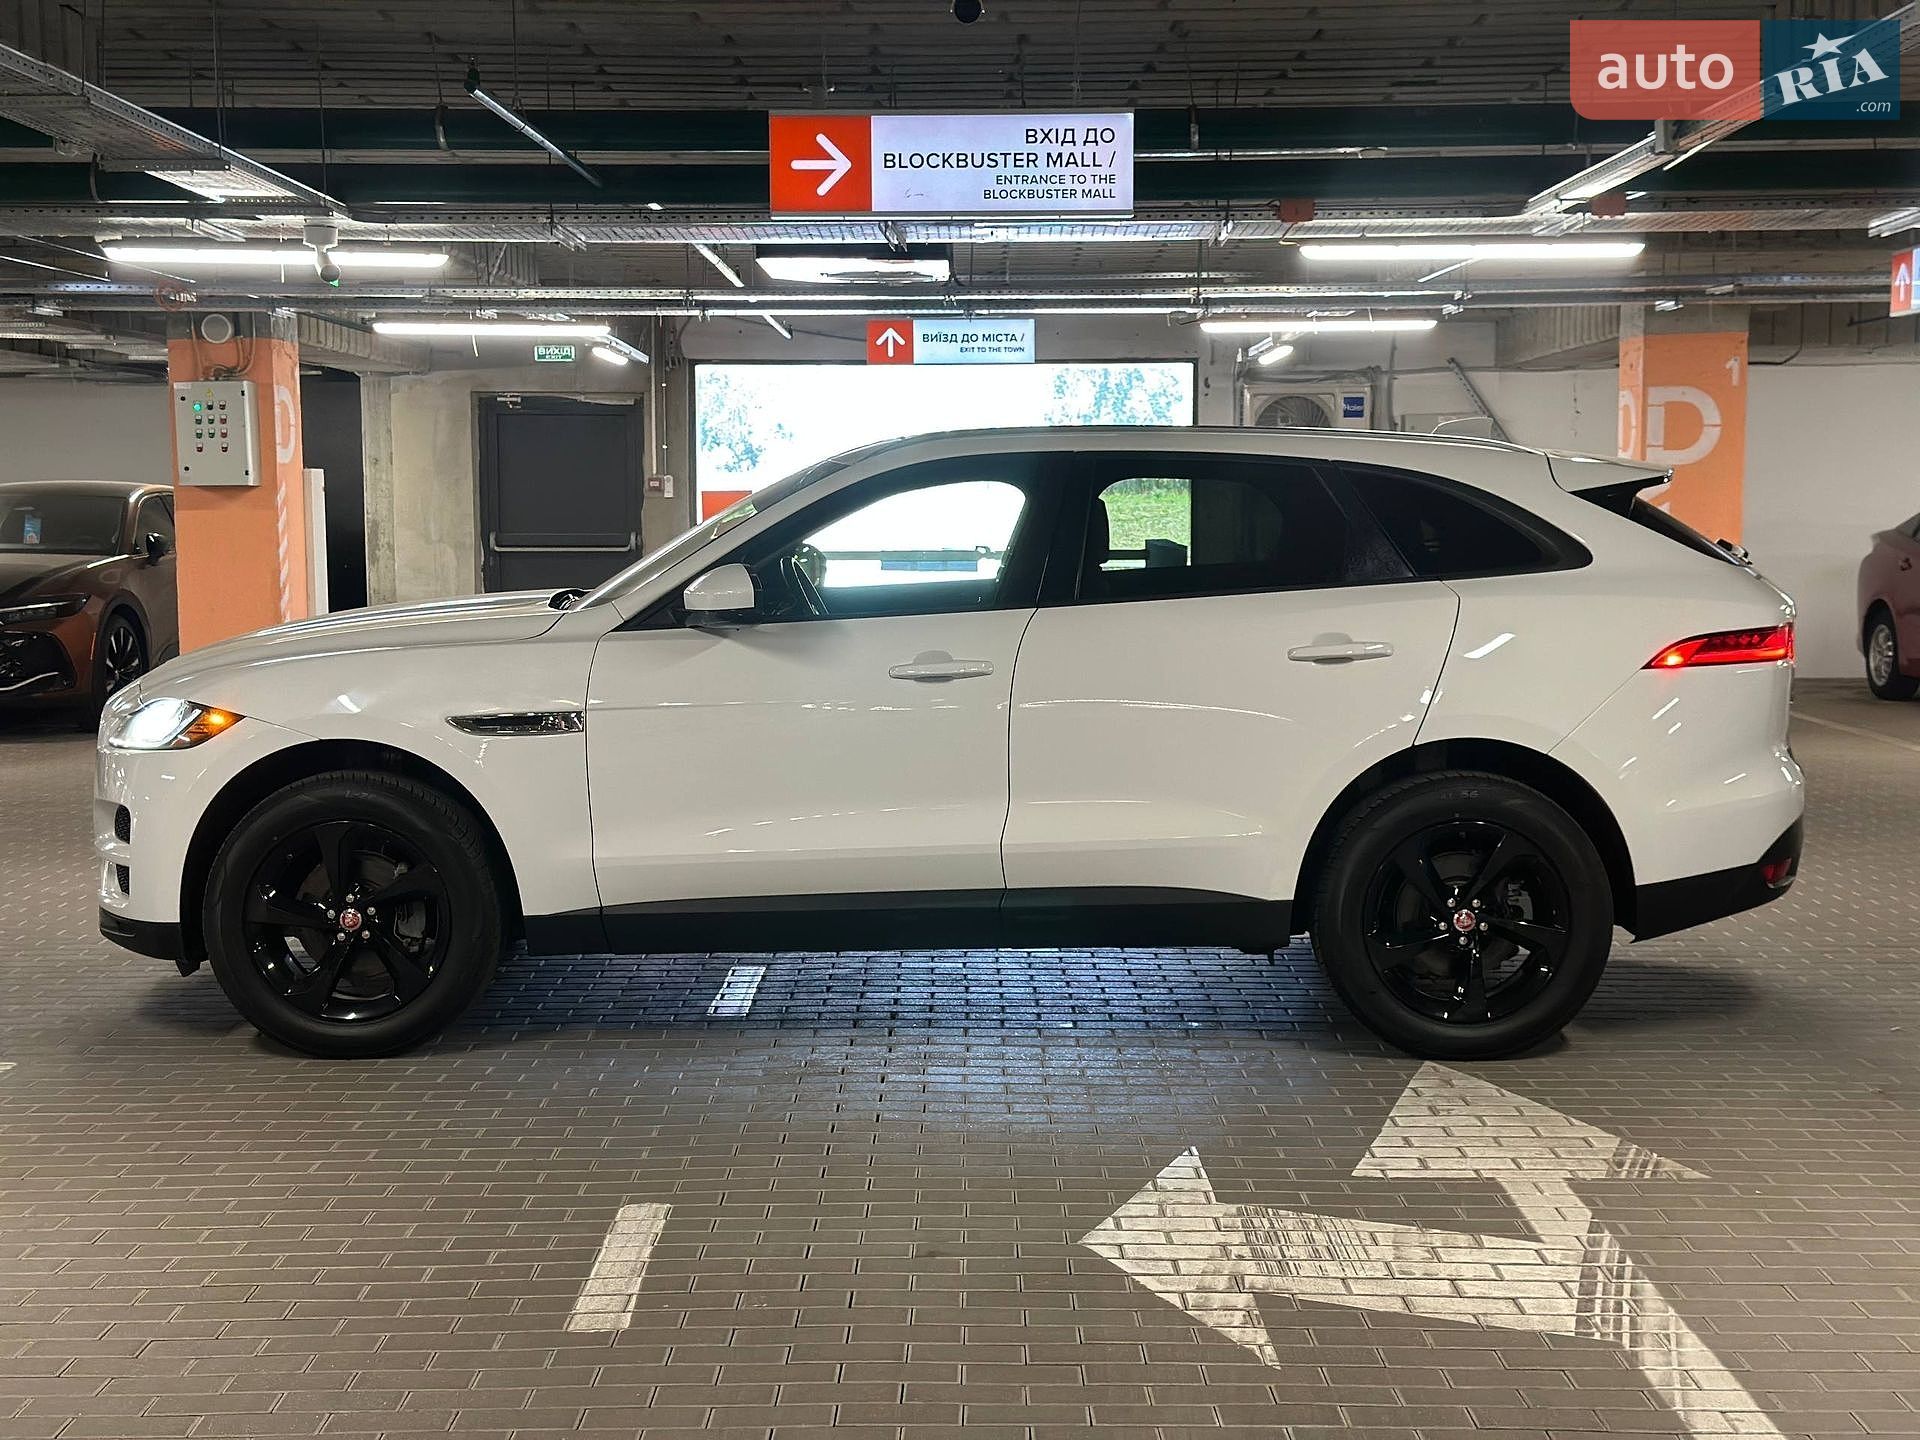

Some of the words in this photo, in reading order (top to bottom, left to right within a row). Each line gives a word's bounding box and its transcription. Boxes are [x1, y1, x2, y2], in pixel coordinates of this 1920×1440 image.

[1025, 128, 1077, 146] ВХІД
[1083, 128, 1116, 146] ДО
[883, 152, 1038, 169] BLOCKBUSTER
[1045, 152, 1102, 168] MALL
[995, 174, 1066, 185] ENTRANCE
[1069, 174, 1086, 185] TO
[1089, 174, 1116, 185] THE
[983, 188, 1078, 200] BLOCKBUSTER
[1080, 188, 1116, 199] MALL
[923, 331, 958, 344] ВИЇЗД
[961, 333, 979, 344] ДО
[982, 332, 1018, 343] МІСТА
[538, 346, 571, 356] ВИХІД
[1725, 355, 1740, 386] 1
[1646, 386, 1722, 465] D
